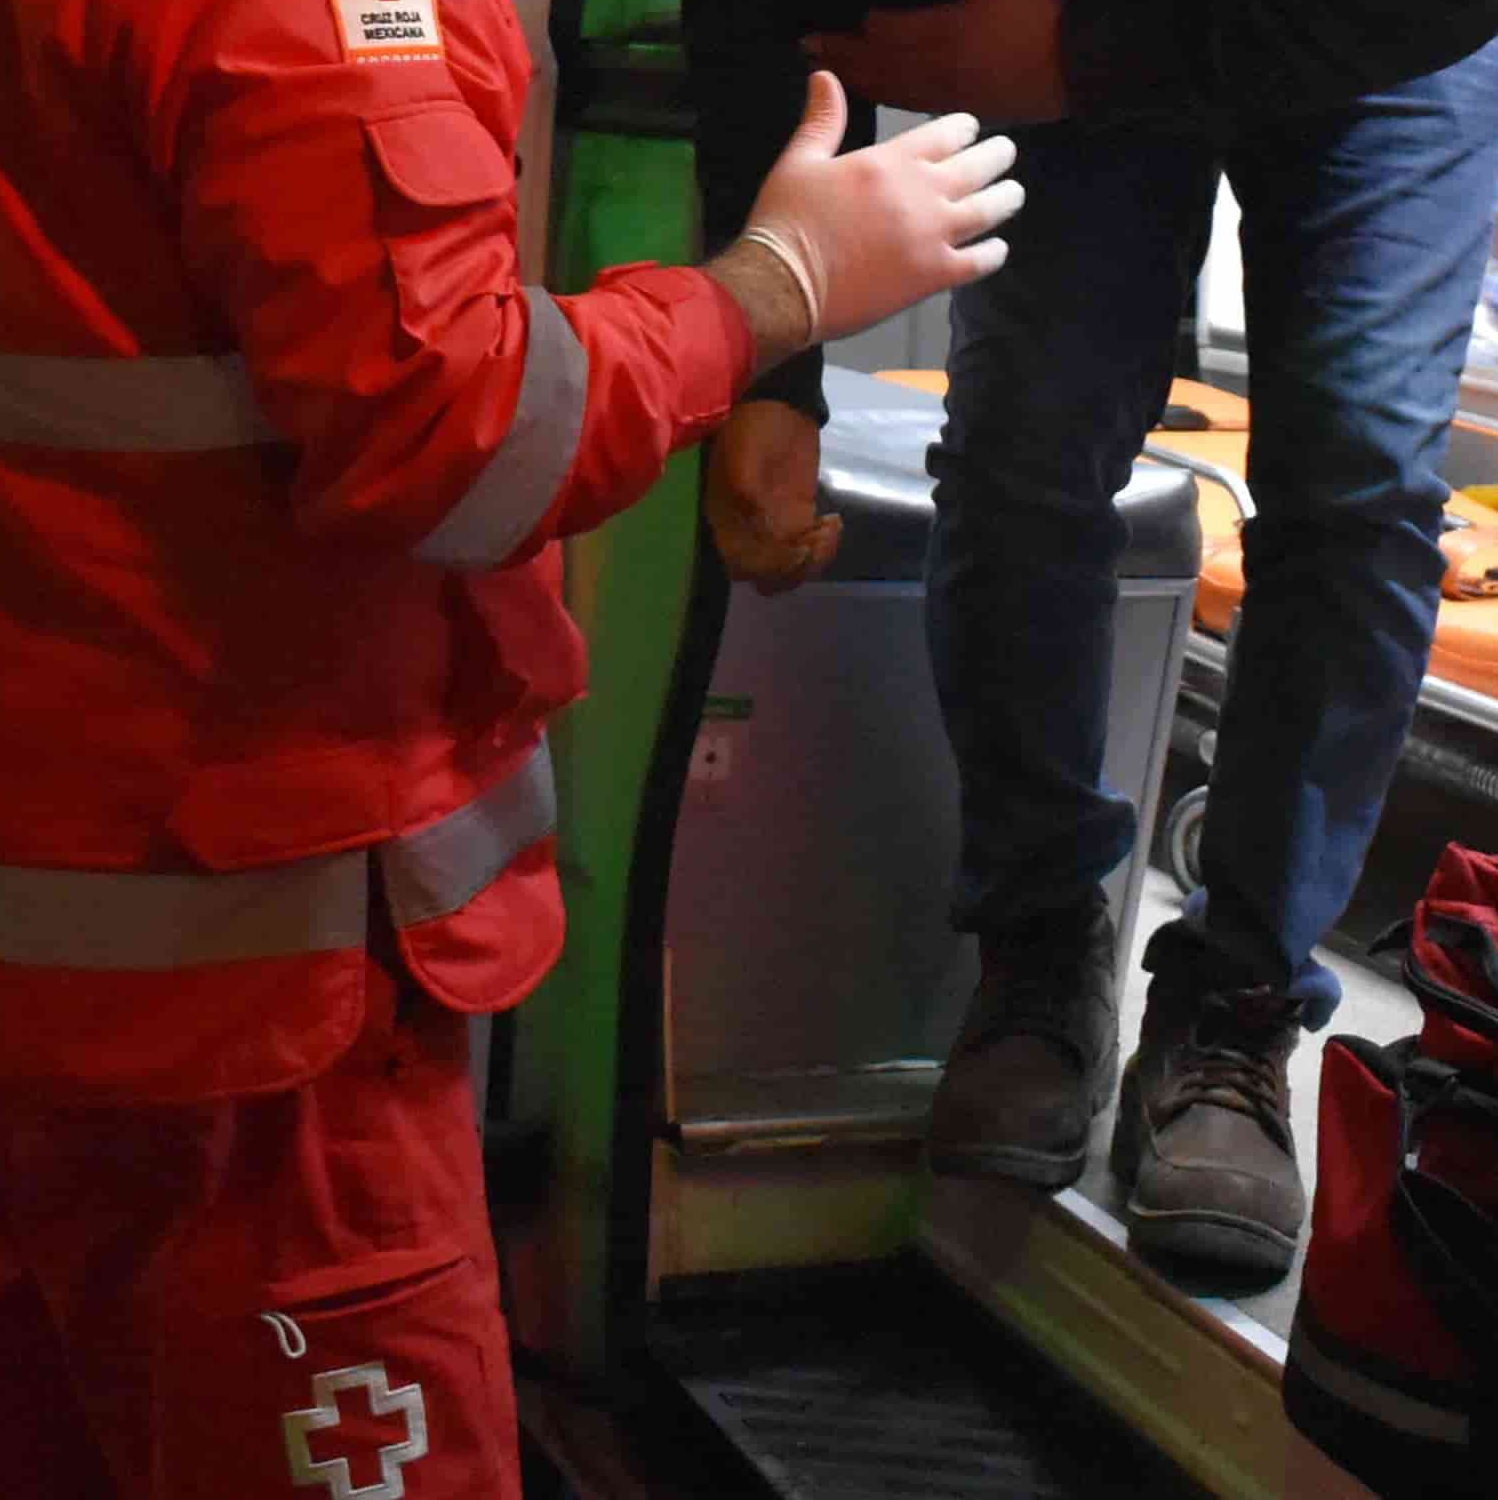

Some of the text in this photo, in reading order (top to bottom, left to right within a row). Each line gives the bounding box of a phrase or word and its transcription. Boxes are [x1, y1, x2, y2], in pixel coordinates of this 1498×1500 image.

[361, 11, 422, 25] CRUZ ROJA
[364, 26, 425, 40] MEXICANA
